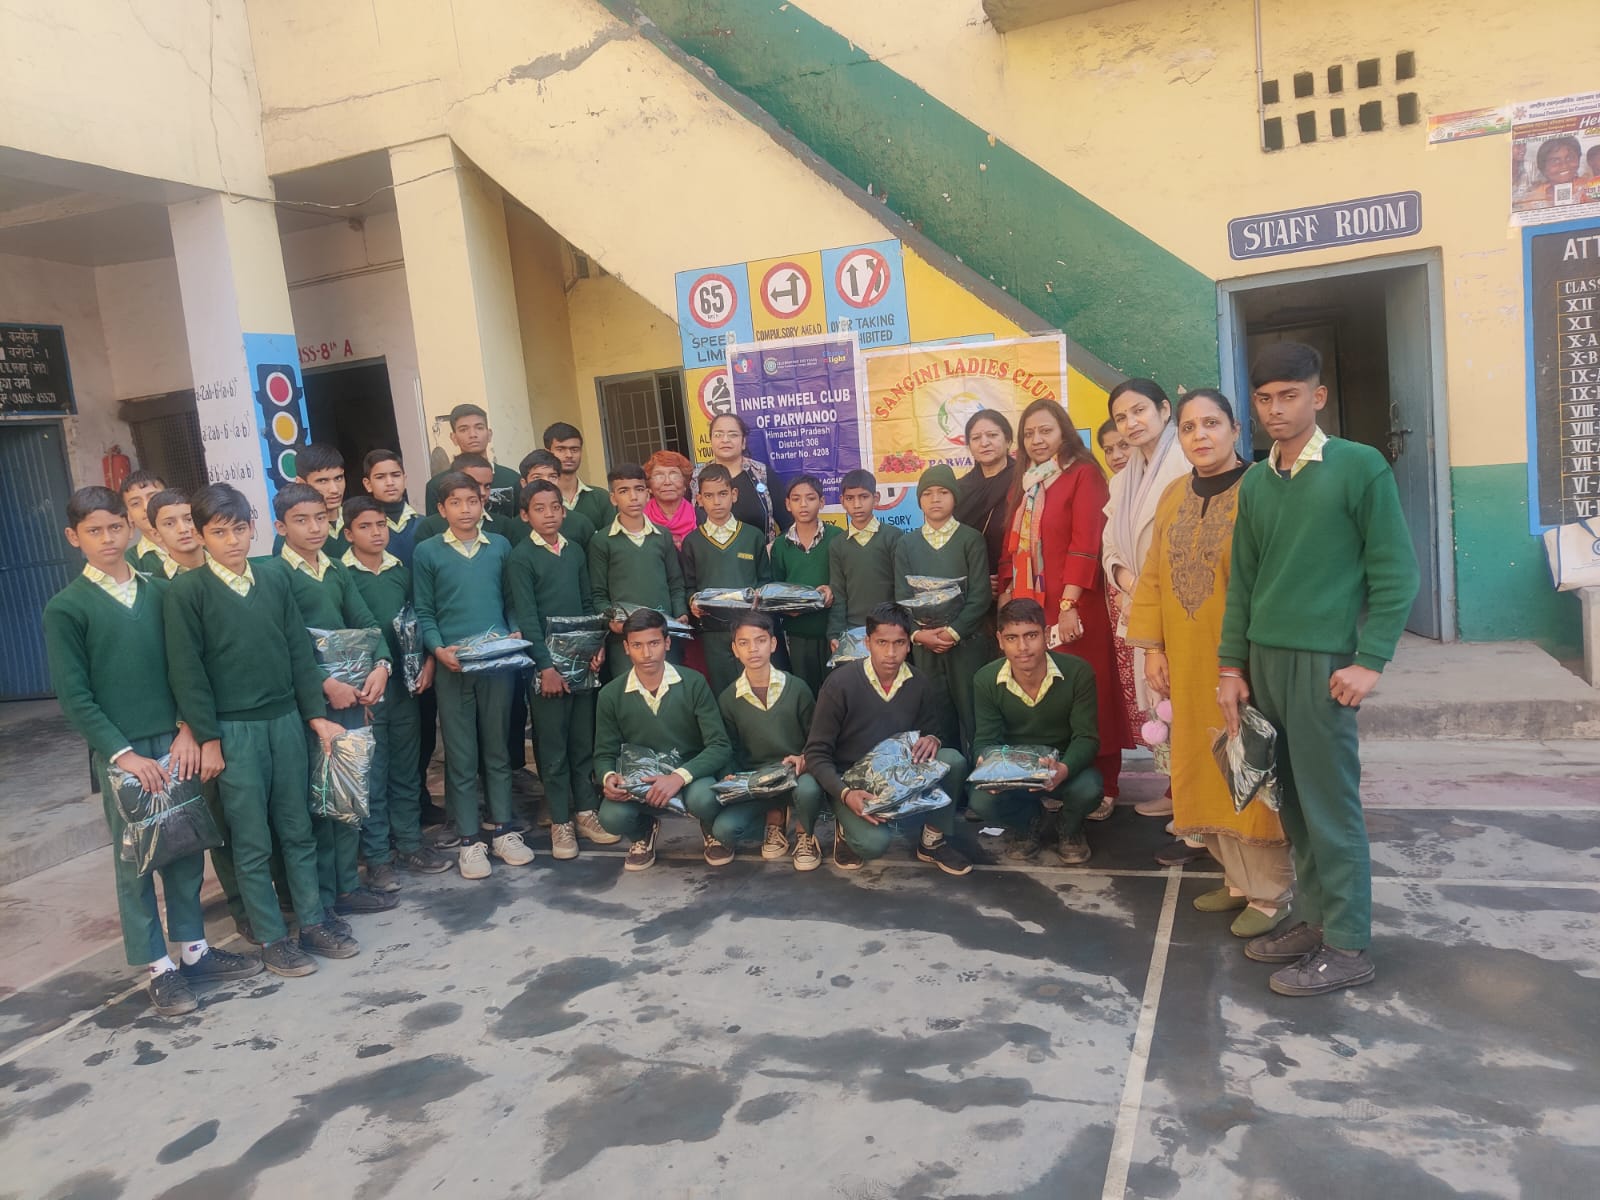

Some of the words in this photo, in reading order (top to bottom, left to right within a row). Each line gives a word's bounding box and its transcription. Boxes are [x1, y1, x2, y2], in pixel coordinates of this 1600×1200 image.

[1243, 214, 1320, 252] STAFF
[1335, 201, 1408, 238] ROOM
[1563, 237, 1600, 261] ATT
[699, 284, 725, 315] 65
[1566, 297, 1596, 313] XII
[855, 313, 895, 329] TAKING
[1567, 315, 1593, 331] XI
[756, 325, 799, 341] COMPULSORY
[801, 322, 822, 335] AHEAD
[859, 330, 893, 344] HIBITED
[343, 339, 353, 357] A
[691, 332, 735, 349] SPEED
[697, 348, 728, 363] LIMI
[875, 362, 940, 419] SANGINI
[943, 357, 1009, 379] LADIES
[741, 395, 775, 411] INNER
[778, 391, 817, 407] WHEEL
[820, 388, 850, 403] CLUB
[756, 415, 771, 428] OF
[774, 409, 837, 427] PARWANOO
[1570, 404, 1600, 418] VIII-
[766, 428, 799, 438] Himachal
[800, 427, 830, 437] Pradesh
[1570, 421, 1600, 437] VIII-
[778, 440, 805, 448] District
[769, 451, 797, 460] Charter
[928, 457, 973, 467] PARWA
